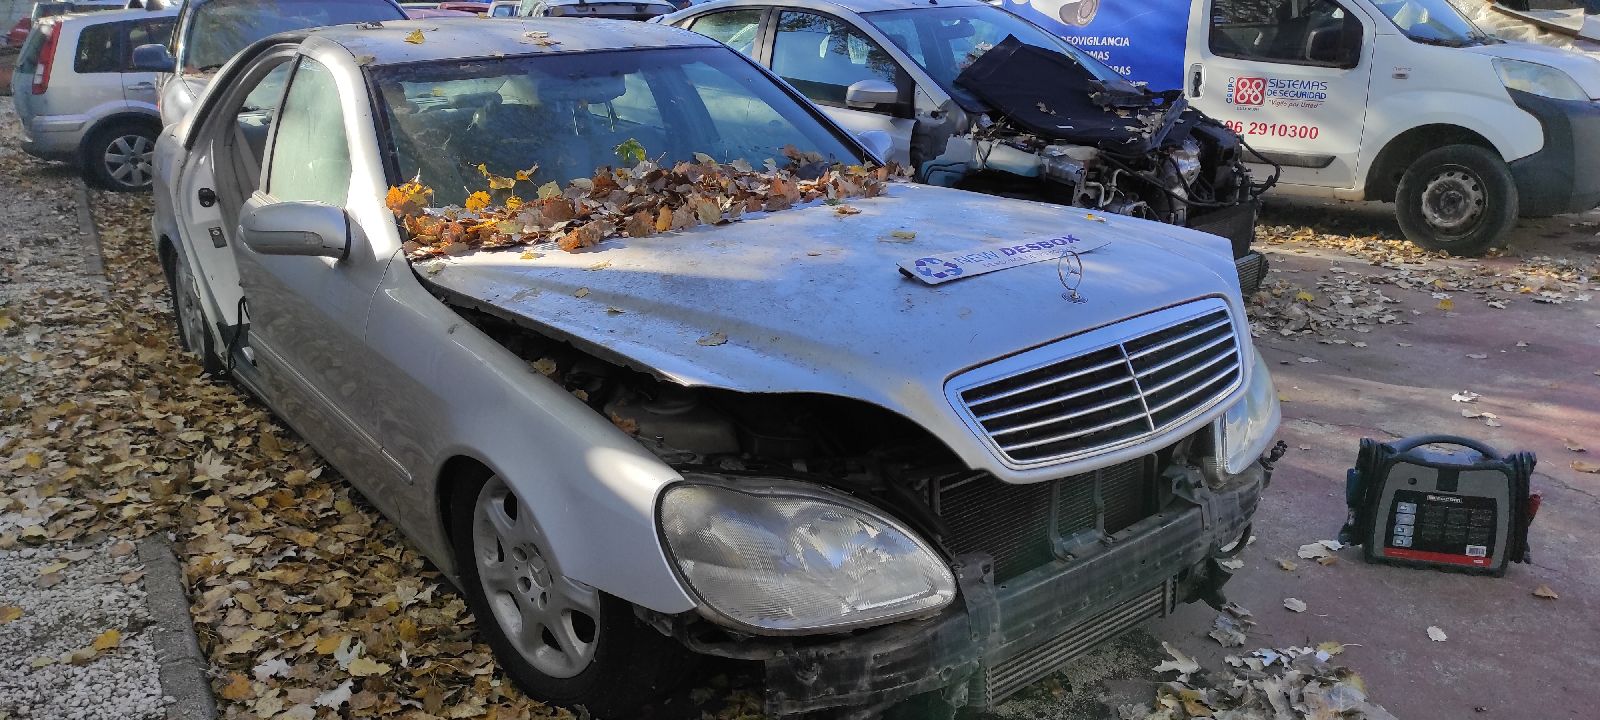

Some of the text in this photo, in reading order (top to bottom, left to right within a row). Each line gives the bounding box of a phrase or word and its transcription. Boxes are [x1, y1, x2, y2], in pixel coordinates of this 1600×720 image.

[1225, 76, 1235, 104] GRUPO
[1268, 78, 1328, 91] SISTEMAS
[1266, 89, 1327, 100] DE SEGURIDAD
[1248, 121, 1319, 140] 2910300
[954, 250, 1000, 265] NEW
[1000, 234, 1081, 257] DESBOX
